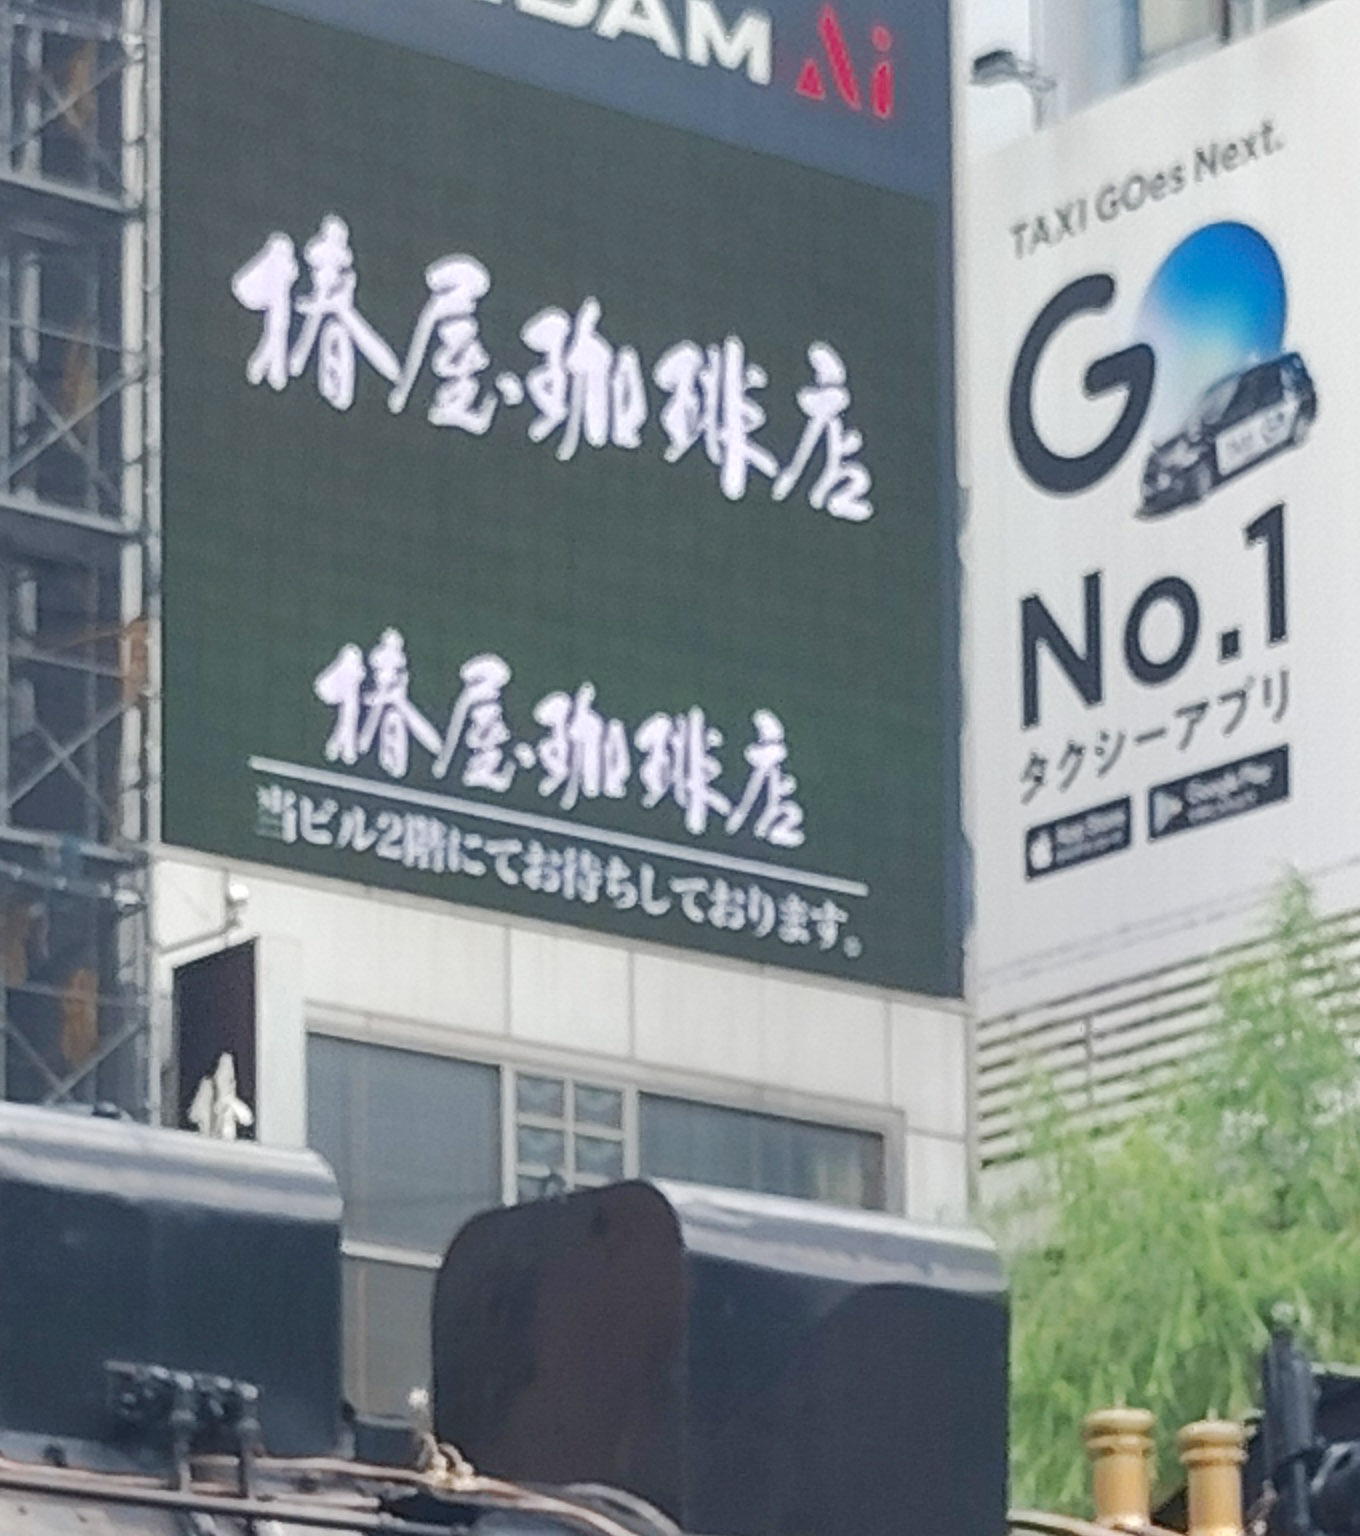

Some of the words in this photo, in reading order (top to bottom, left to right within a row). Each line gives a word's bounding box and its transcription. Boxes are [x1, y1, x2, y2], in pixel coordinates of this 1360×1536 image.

[1010, 199, 1088, 259] TAXI
[1095, 171, 1187, 223] GOes
[1193, 121, 1285, 182] Next.
[231, 213, 874, 522] 椿屋珈琲店
[1020, 502, 1288, 730] No.1
[314, 627, 807, 848] 椿屋珈琲店
[1020, 669, 1291, 804] タクシーアプリ
[256, 784, 863, 959] 当ビル2階にてお待ちしております。
